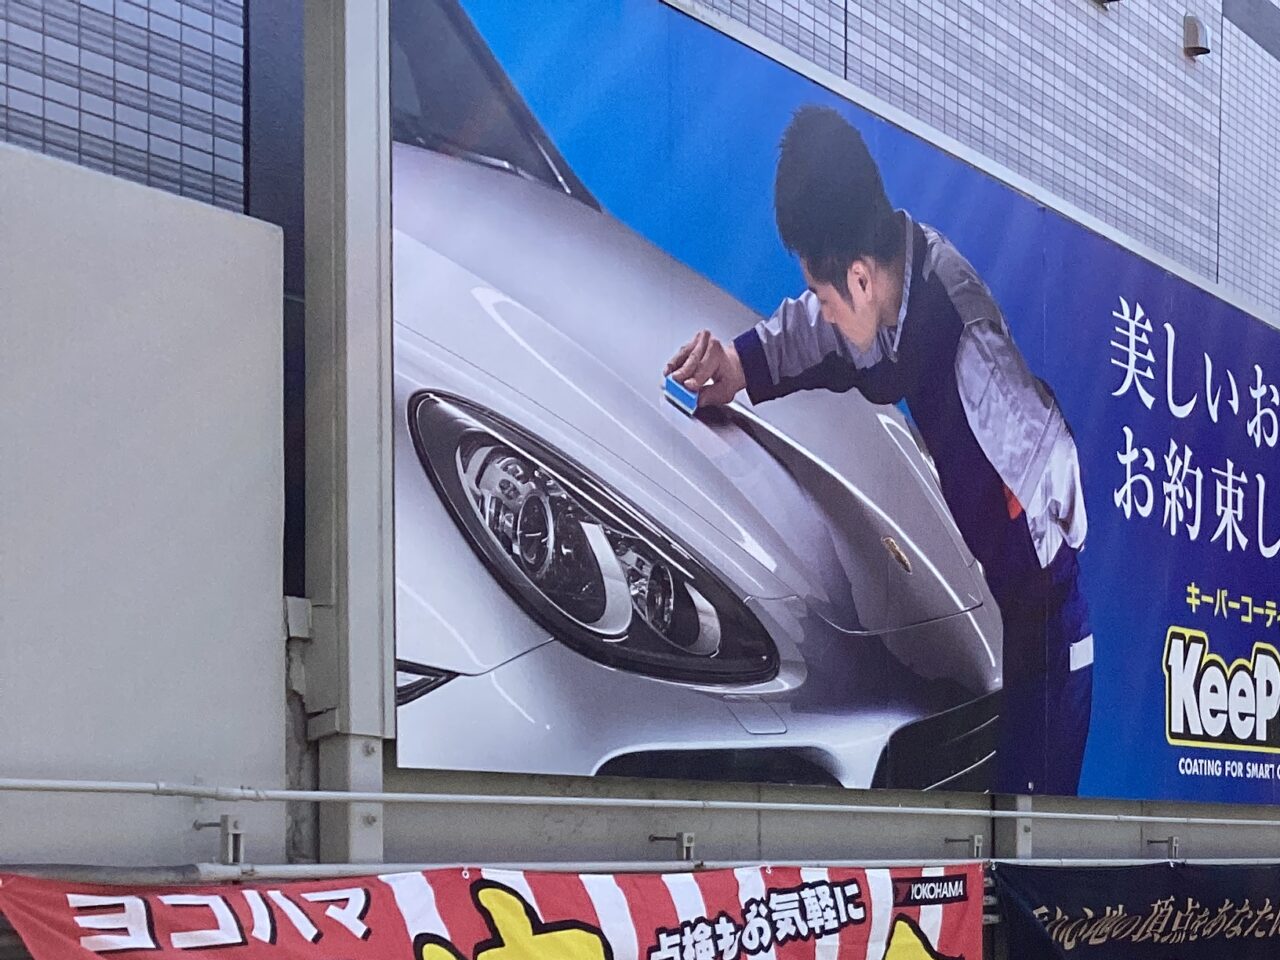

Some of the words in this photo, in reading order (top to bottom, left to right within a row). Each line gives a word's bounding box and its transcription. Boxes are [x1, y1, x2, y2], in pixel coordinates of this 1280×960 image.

[1178, 756, 1223, 777] COATING
[1225, 760, 1244, 778] FOR
[1246, 763, 1276, 779] SMART
[909, 879, 965, 901] YOKOHAMA
[65, 888, 371, 952] ヨコハマ
